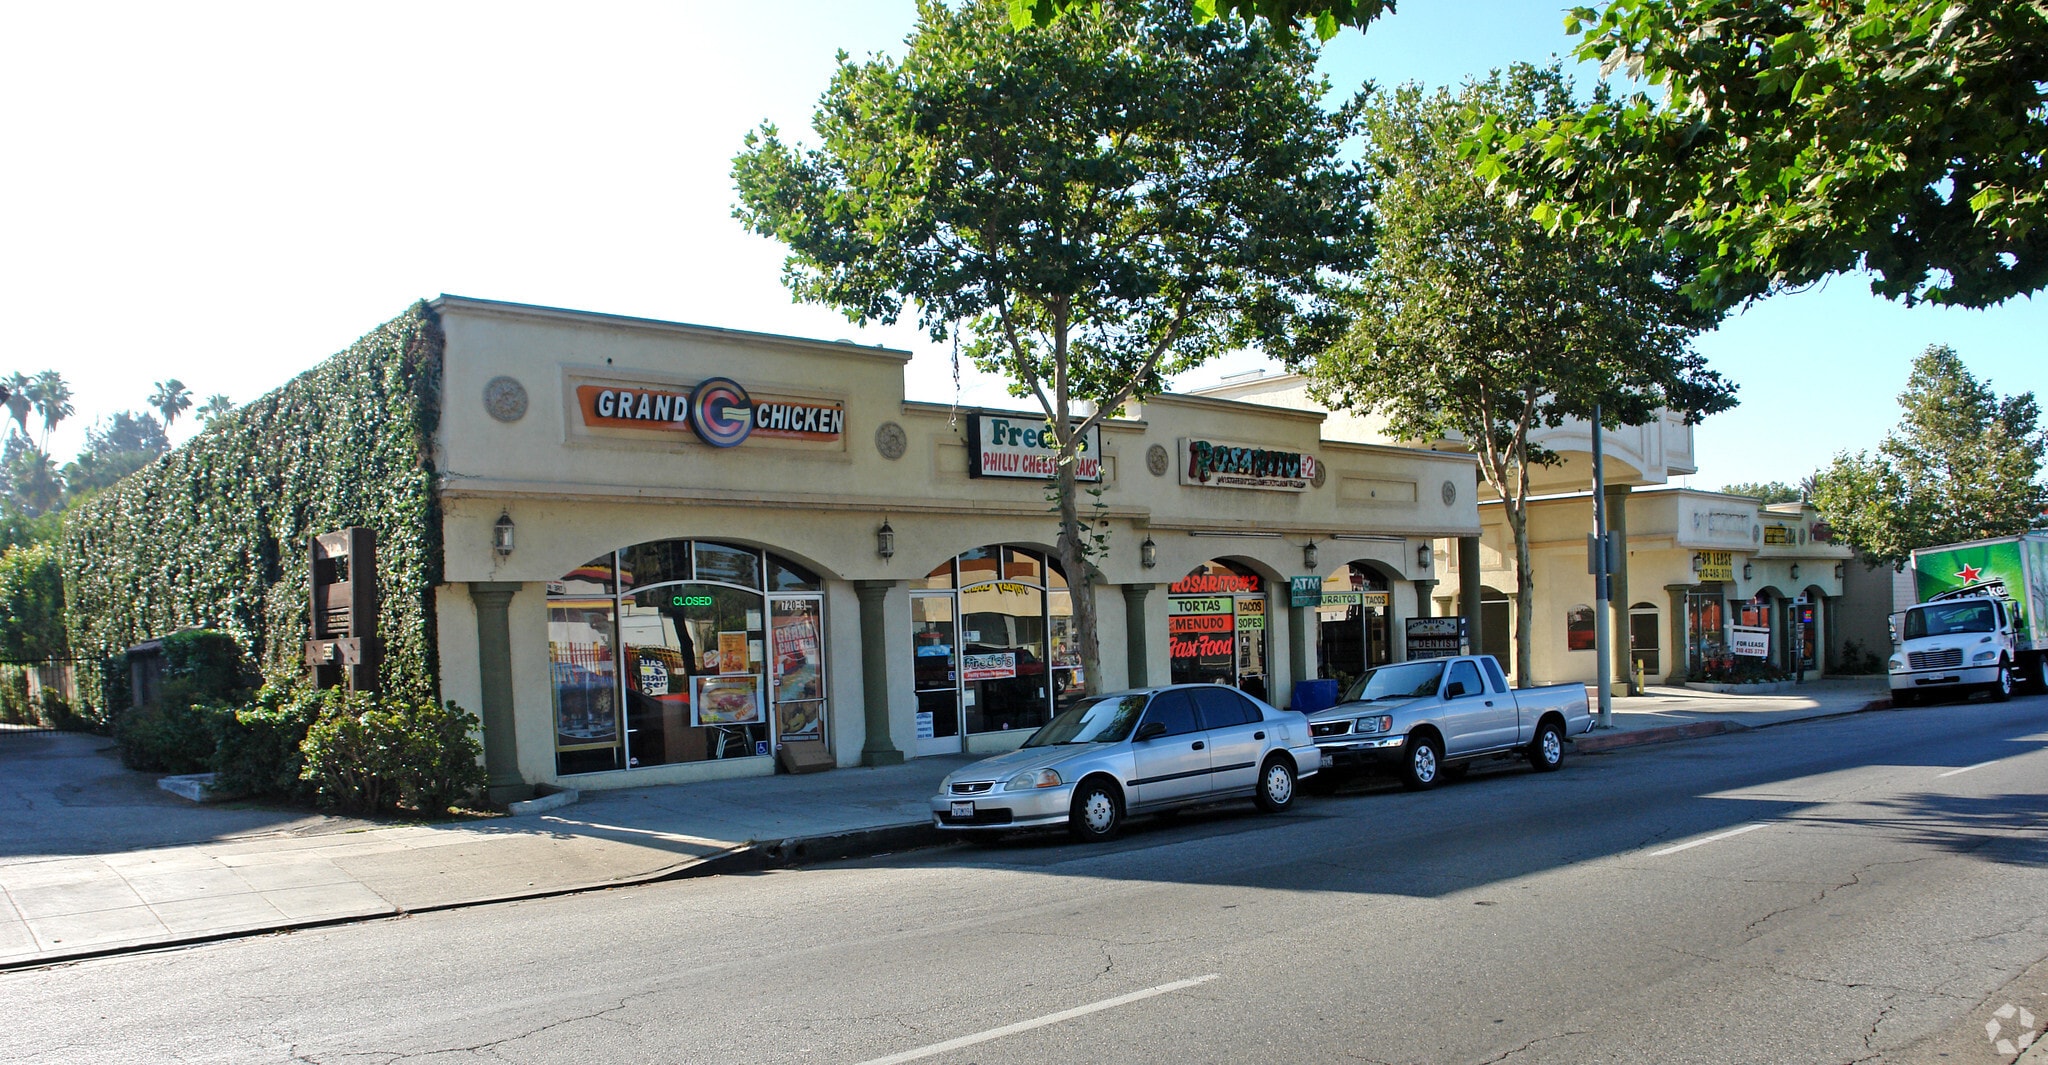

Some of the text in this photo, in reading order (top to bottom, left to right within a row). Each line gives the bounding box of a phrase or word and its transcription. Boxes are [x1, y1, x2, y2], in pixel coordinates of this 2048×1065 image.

[598, 389, 688, 422] GRAND
[756, 402, 844, 433] CHICKEN
[992, 419, 1089, 452] Fred's
[983, 451, 1019, 473] PHILLY
[1189, 441, 1314, 482] ROSARITO #2
[1712, 553, 1732, 566] LEASE
[1293, 578, 1320, 590] ATM
[673, 596, 712, 606] CLOSED
[1178, 600, 1221, 612] TORTAS
[1238, 601, 1262, 611] TACOS
[1321, 595, 1357, 604] URRITOS
[1365, 595, 1386, 605] TACOS
[1175, 617, 1224, 630] MENUDO
[1238, 618, 1262, 628] SOPES
[1408, 619, 1445, 631] ROSARITO
[775, 624, 814, 643] GRAND
[778, 638, 816, 654] CHICKEN
[1170, 635, 1234, 659] Fast Food
[1418, 639, 1457, 648] DENTIST
[963, 654, 1014, 669] Fredo's
